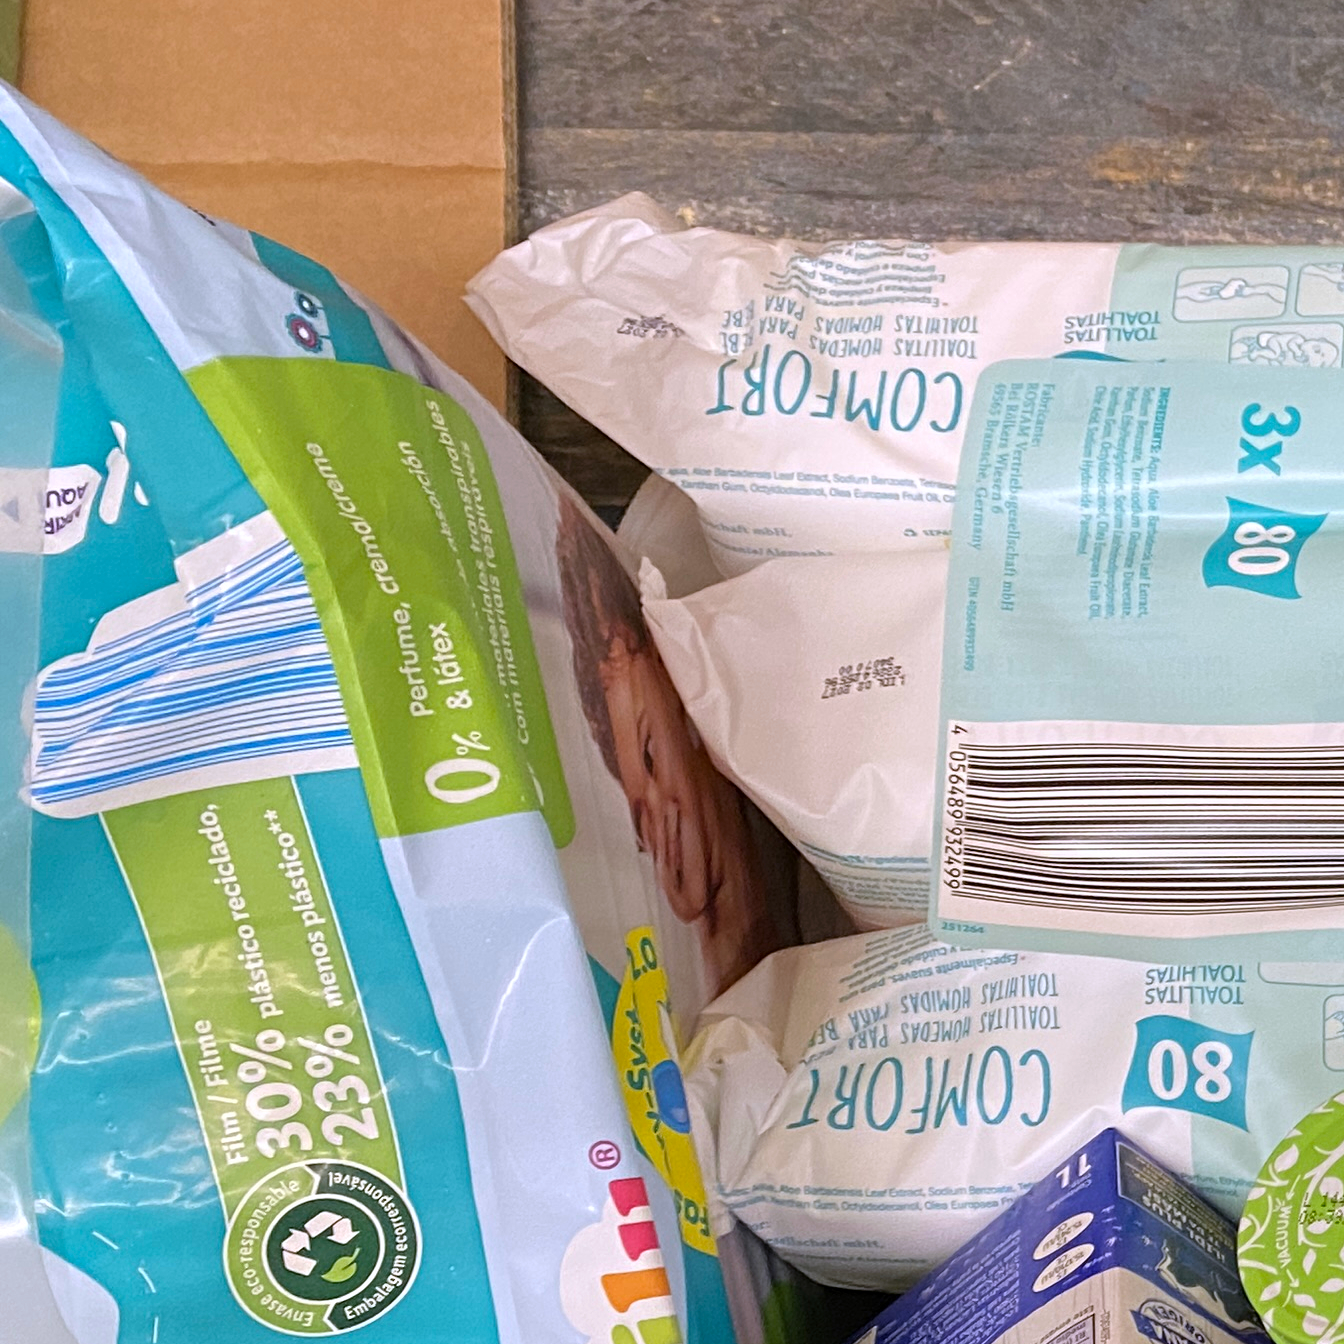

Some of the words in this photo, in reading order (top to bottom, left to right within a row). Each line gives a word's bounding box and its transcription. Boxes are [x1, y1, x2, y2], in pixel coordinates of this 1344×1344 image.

[895, 317, 979, 334] TOALHITAS
[895, 339, 978, 359] TOALLITAS
[1064, 311, 1160, 327] TOALHITAS
[1064, 327, 1158, 344] TOALLITAS
[706, 344, 963, 432] COMFORT
[1008, 383, 1023, 401] Bei
[1017, 383, 1039, 437] ROSTAM
[976, 419, 999, 483] Bramsche,
[1238, 402, 1300, 476] 3x
[426, 399, 484, 558] transpirables
[991, 453, 1010, 500] Wiesen
[1148, 488, 1160, 511] Aloe
[306, 442, 400, 595] crema/creme
[968, 487, 987, 551] Germany
[991, 505, 1004, 514] 6
[1003, 442, 1027, 577] Vertriebsgesellschaft
[1139, 563, 1153, 579] Leaf
[1227, 521, 1296, 576] 80
[1001, 581, 1014, 612] mbH
[1138, 583, 1151, 618] Extract,
[393, 600, 435, 718] Perfume,
[428, 622, 463, 686] látex
[447, 687, 473, 710] &
[950, 724, 968, 737] 4
[424, 731, 501, 804] 0%
[947, 749, 969, 820] 056489
[197, 802, 251, 926] reciclado,
[943, 826, 968, 891] 932499
[941, 920, 986, 936] 251264
[236, 922, 283, 1020] plástico
[302, 922, 344, 1008] menos
[935, 953, 1019, 976] Especialmente
[981, 972, 1059, 1000] TOALHITAS
[1145, 964, 1246, 985] TOALHITAS
[979, 1005, 1061, 1034] TOALLITAS
[1145, 985, 1244, 1005] TOALLITAS
[194, 1019, 229, 1090] Filme
[848, 1023, 889, 1050] PARA
[230, 1028, 314, 1160] 30%
[297, 1022, 380, 1148] 23%
[787, 1046, 1051, 1134] COMFORT
[1147, 1039, 1233, 1103] 80
[218, 1110, 250, 1166] Film
[238, 1178, 300, 1290] eco-responsable
[328, 1172, 409, 1252] ecorresponsável
[1279, 1206, 1292, 1270] VACUUM
[260, 1290, 314, 1329] Envase
[344, 1252, 408, 1322] Embalagem
